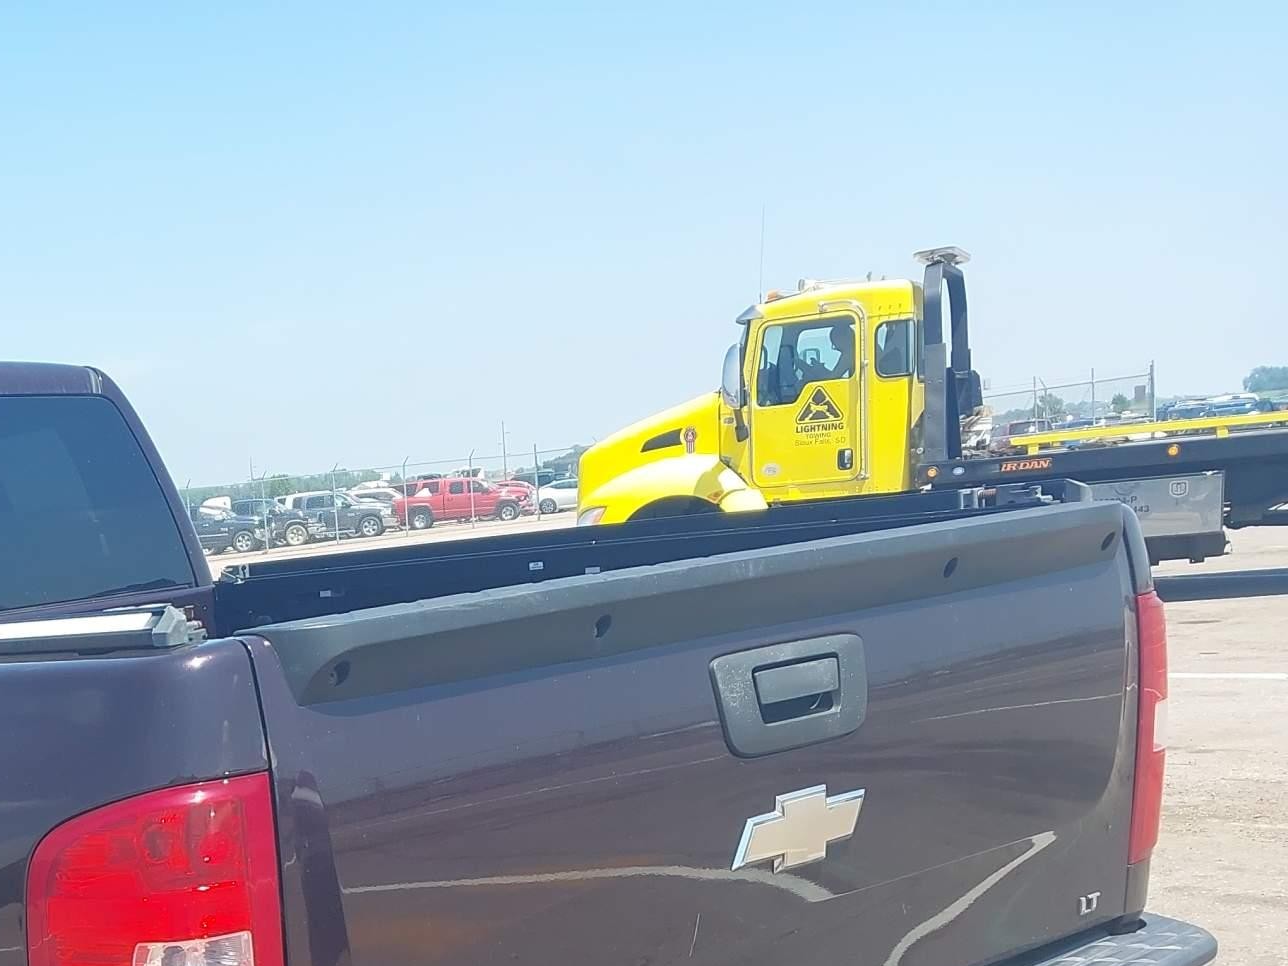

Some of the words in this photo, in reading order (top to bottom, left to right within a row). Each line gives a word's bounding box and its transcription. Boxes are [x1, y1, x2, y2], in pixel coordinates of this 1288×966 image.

[795, 422, 844, 434] LIGHTNING
[806, 432, 831, 440] TOWING
[1079, 891, 1101, 915] LT
